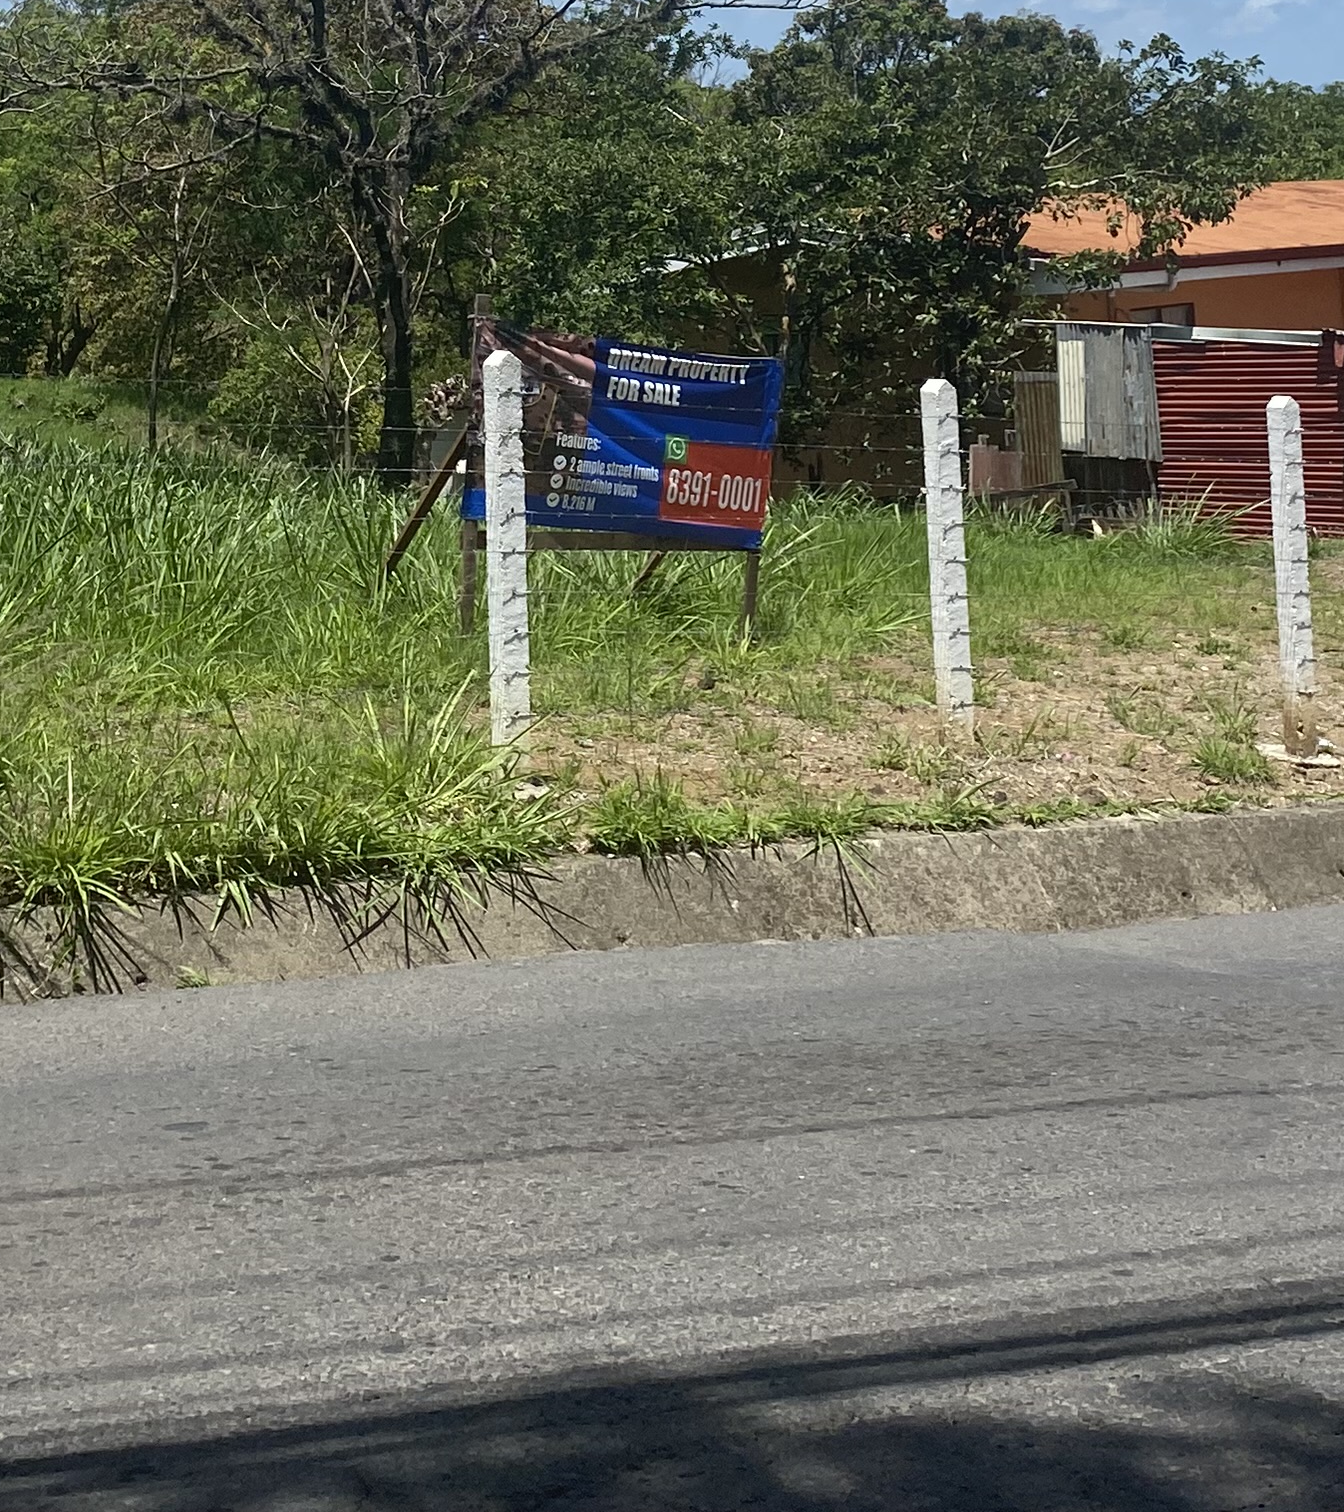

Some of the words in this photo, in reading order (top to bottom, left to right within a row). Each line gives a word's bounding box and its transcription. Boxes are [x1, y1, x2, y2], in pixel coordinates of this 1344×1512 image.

[608, 348, 667, 375] DREAM
[668, 357, 750, 384] PROPERTY
[607, 376, 640, 401] FOR
[643, 381, 681, 406] SALE
[556, 432, 601, 451] Features:
[569, 456, 576, 472] 2
[577, 460, 605, 475] ample
[606, 462, 633, 478] street
[633, 465, 659, 482] fronts
[565, 476, 612, 495] Incredible
[613, 481, 638, 498] views
[667, 469, 762, 512] 8391-0001
